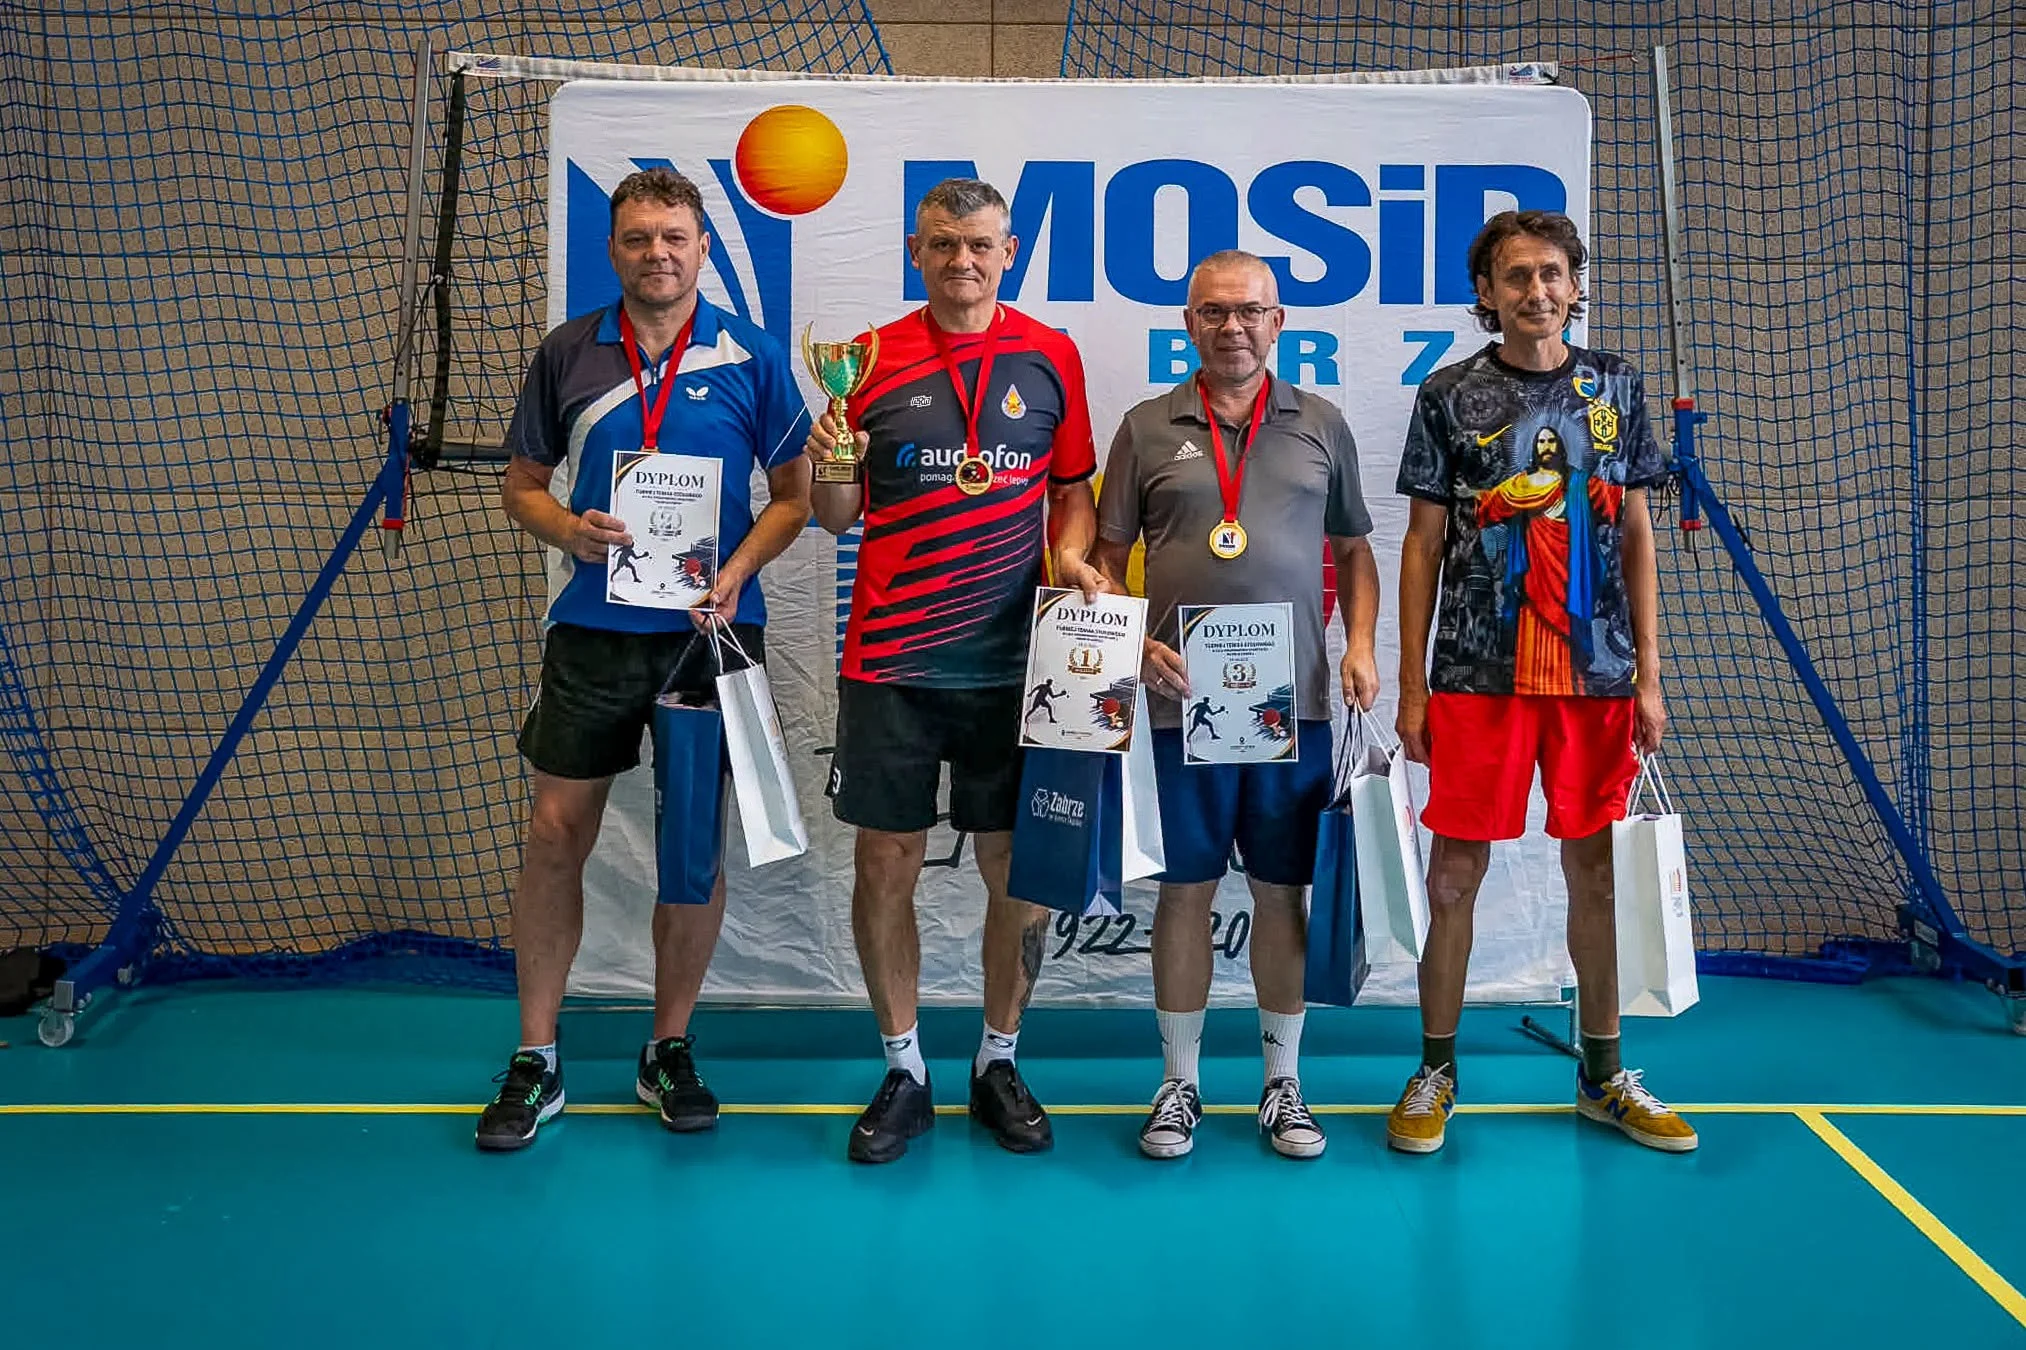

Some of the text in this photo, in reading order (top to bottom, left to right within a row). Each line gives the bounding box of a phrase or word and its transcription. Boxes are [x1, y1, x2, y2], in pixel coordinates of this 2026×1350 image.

[921, 443, 1031, 470] audofon
[1174, 449, 1204, 461] adidas
[636, 471, 704, 489] DYPLOM
[920, 473, 956, 484] pomag
[1057, 607, 1128, 627] DYPLOM
[1203, 623, 1275, 638] DYPLOM
[1081, 649, 1090, 667] 1
[1232, 663, 1246, 682] 3
[1050, 791, 1085, 818] Zabrze
